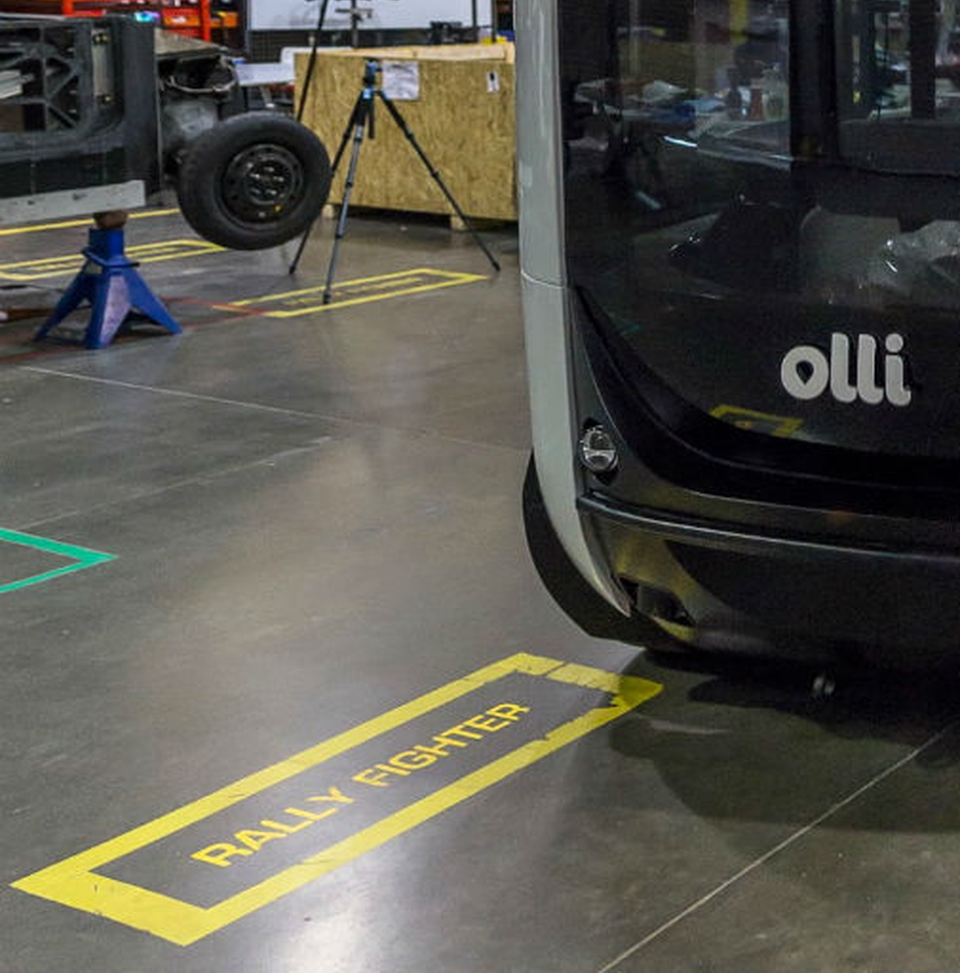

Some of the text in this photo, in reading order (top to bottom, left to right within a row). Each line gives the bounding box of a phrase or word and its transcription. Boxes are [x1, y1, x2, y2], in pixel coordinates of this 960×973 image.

[781, 332, 911, 405] olli
[191, 703, 530, 867] RALLY FIGHTER
